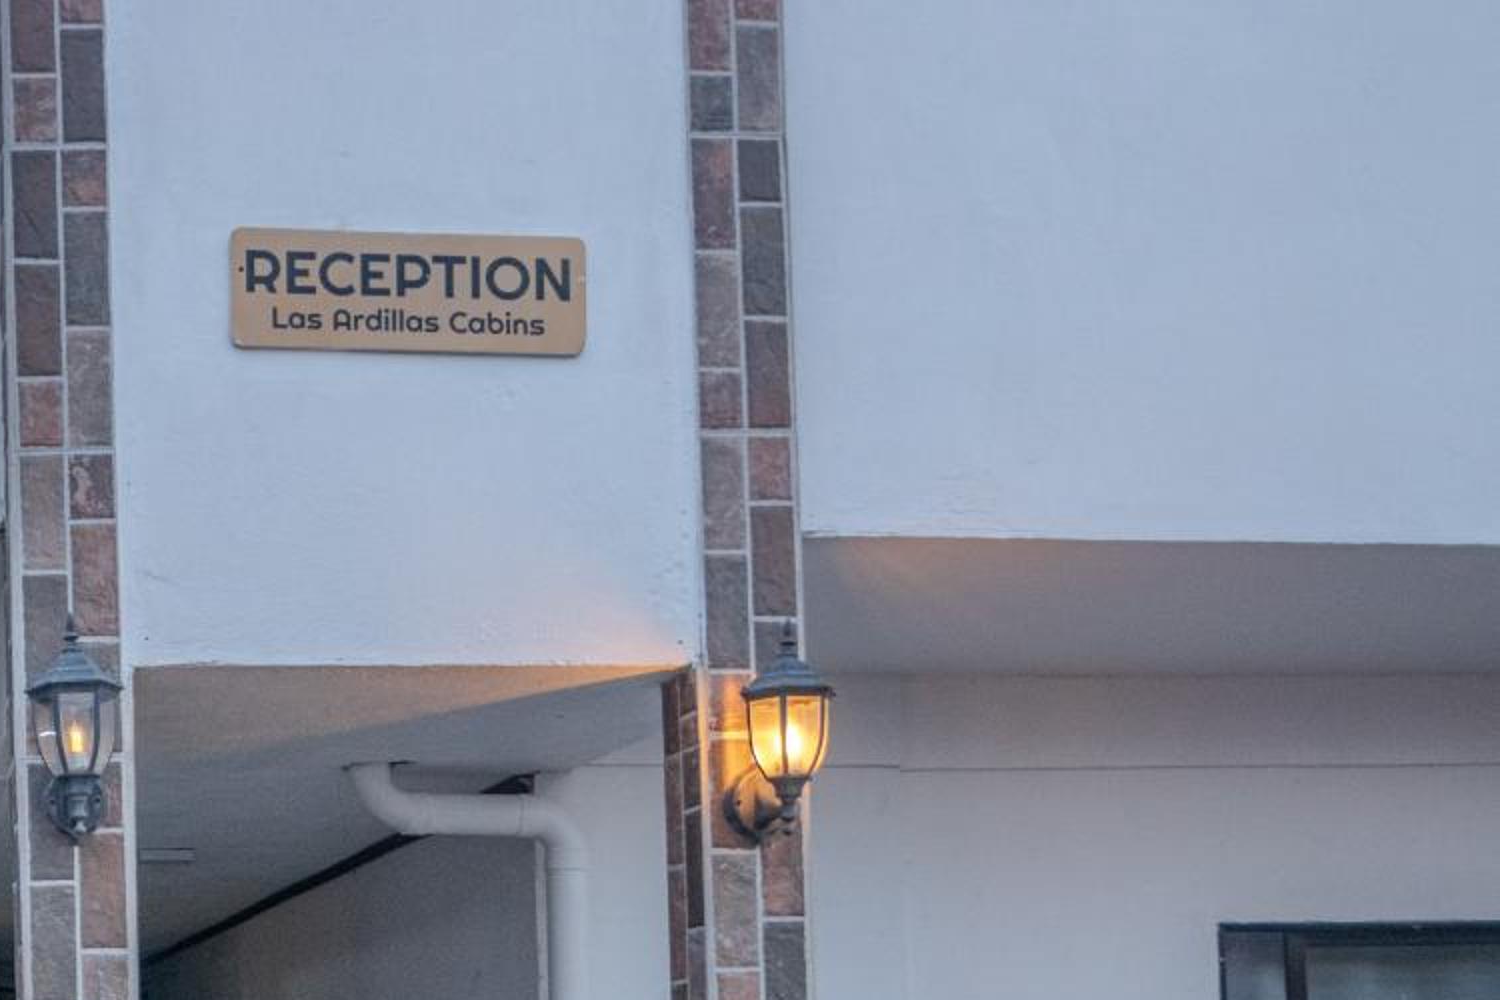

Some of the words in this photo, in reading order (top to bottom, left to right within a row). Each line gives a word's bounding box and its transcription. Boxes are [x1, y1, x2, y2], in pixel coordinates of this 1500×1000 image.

[244, 249, 571, 302] RECEPTION
[271, 306, 323, 330] Las
[333, 308, 440, 334] Ardillas
[449, 311, 546, 336] Cabins
